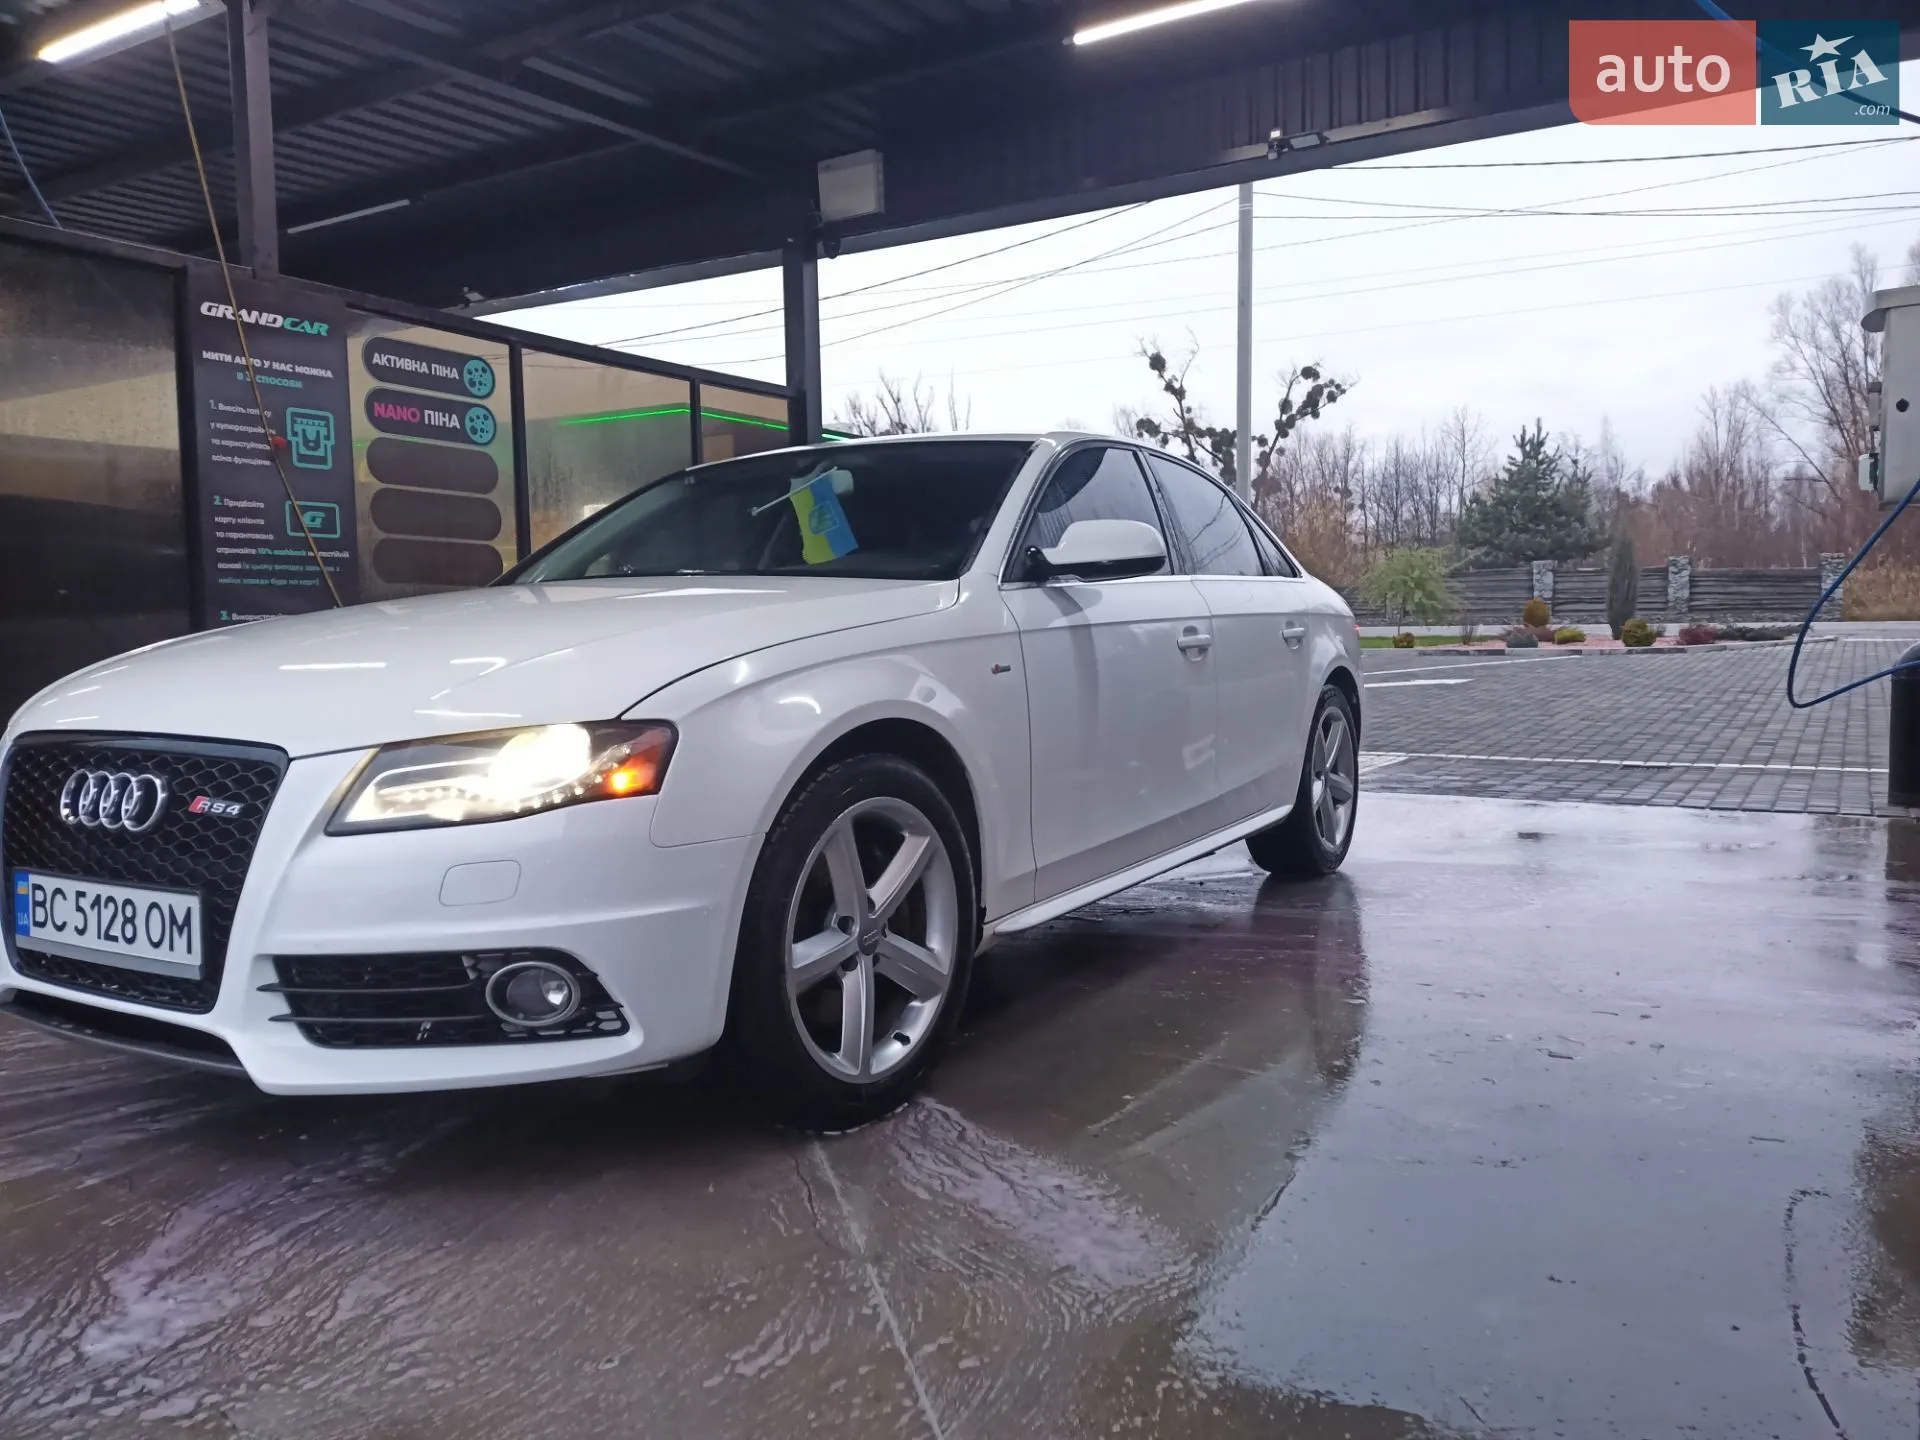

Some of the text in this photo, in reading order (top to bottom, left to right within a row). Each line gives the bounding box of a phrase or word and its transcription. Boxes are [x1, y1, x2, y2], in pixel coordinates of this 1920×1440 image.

[202, 350, 232, 363] МИТИ
[263, 360, 271, 369] У
[272, 361, 293, 372] НАС
[295, 364, 333, 378] МОЖНА
[372, 352, 460, 380] АКТИВНА ПІНА
[373, 402, 461, 430] NANO ПІНА
[195, 800, 242, 816] RS4
[17, 911, 30, 927] UA
[31, 882, 192, 955] BC 5128 OM
